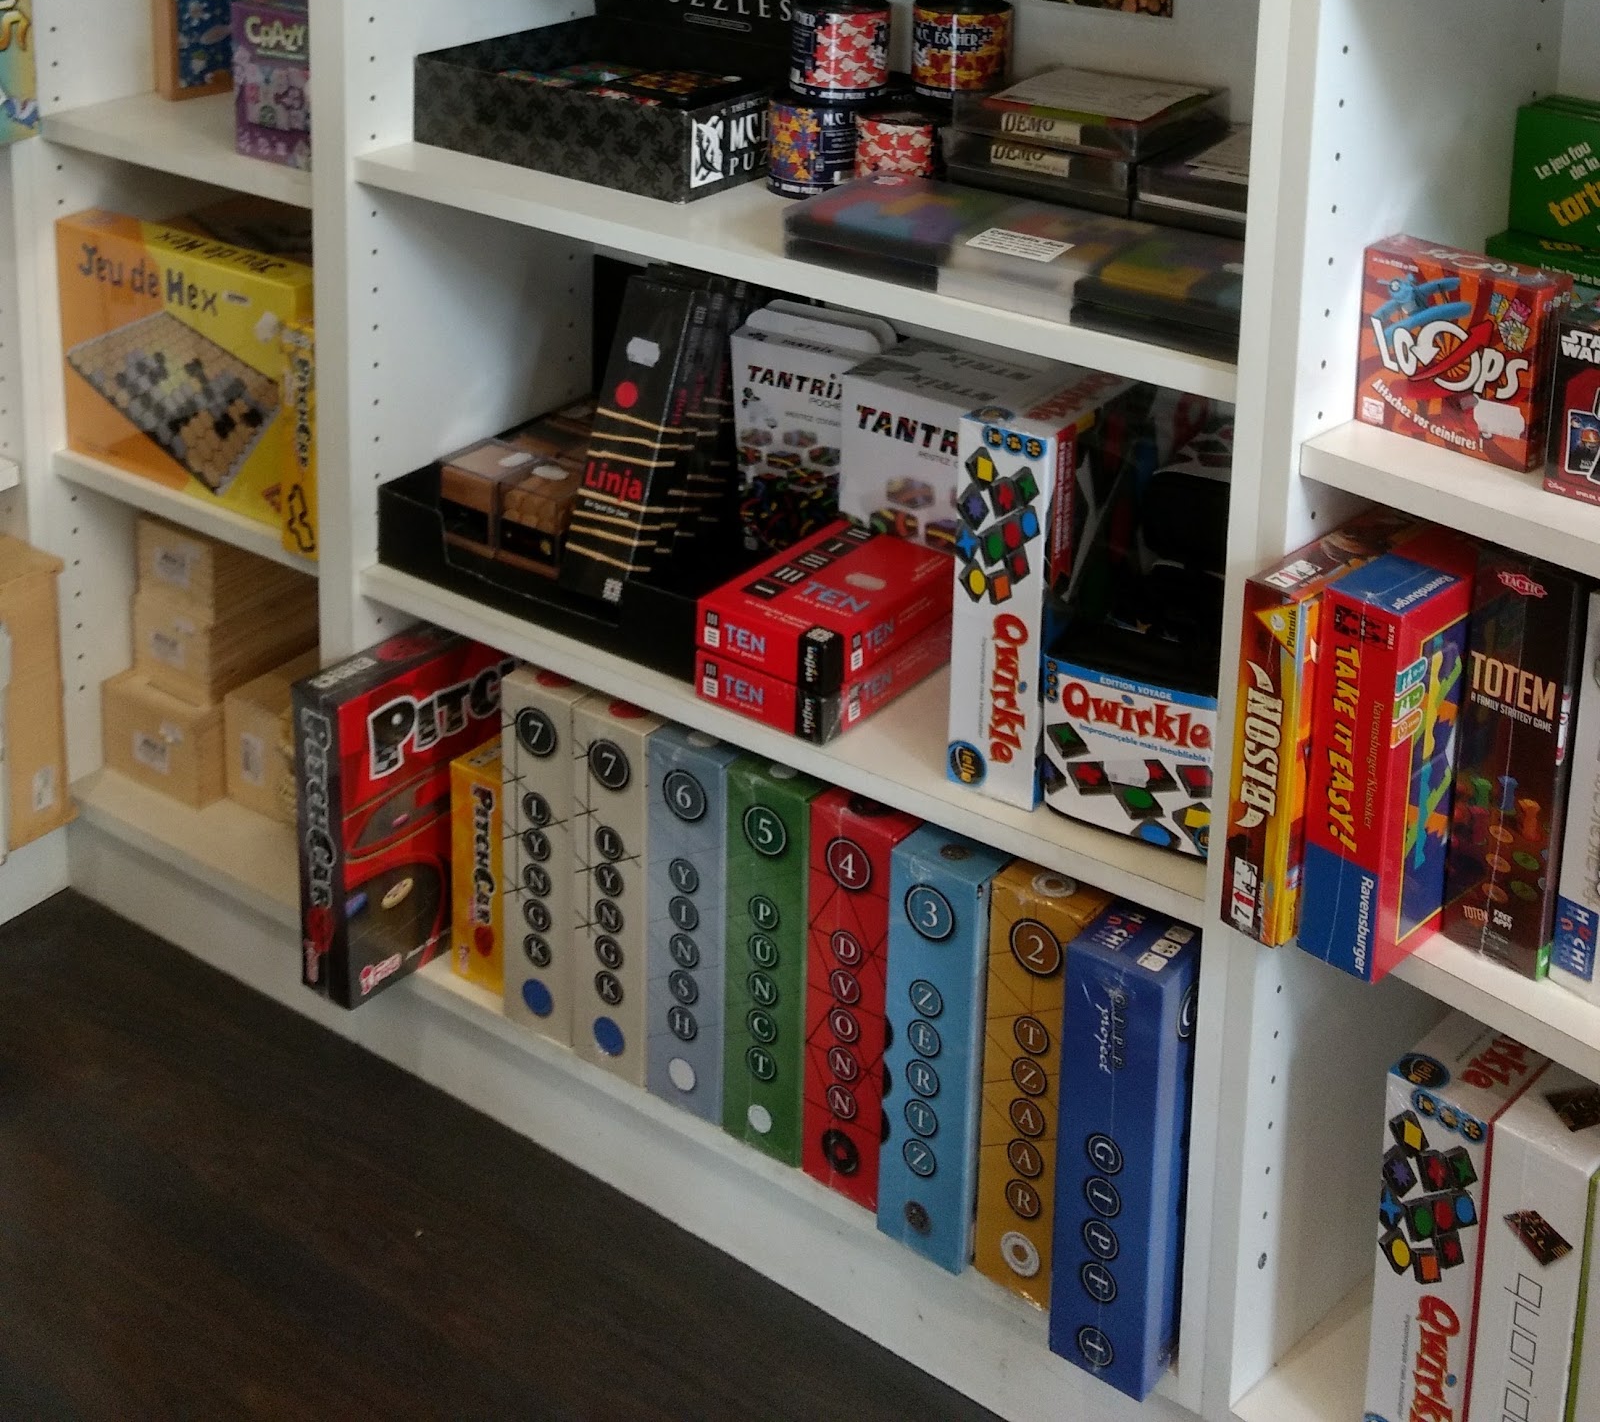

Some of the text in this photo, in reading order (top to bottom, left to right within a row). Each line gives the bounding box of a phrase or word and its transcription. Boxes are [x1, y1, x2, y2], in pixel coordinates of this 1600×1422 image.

[934, 31, 978, 47] ESCHER
[1003, 114, 1055, 133] DEMO
[992, 144, 1044, 162] DEMO
[1534, 141, 1592, 180] Le jeu fou
[1569, 162, 1588, 180] de
[79, 242, 218, 317] Jeu de Hex
[1371, 378, 1413, 419] Attachez
[1413, 412, 1430, 430] vos
[1430, 422, 1477, 451] ceintures
[585, 460, 643, 503] Linja
[799, 580, 871, 615] TEN
[1503, 573, 1544, 595] TACTIC
[723, 624, 766, 655] TEN
[865, 619, 896, 651] TEN
[1286, 609, 1297, 649] Piatnik
[723, 675, 764, 705] TEN
[989, 612, 1030, 766] Qwirkle
[1137, 685, 1172, 701] VOYAGE
[1470, 649, 1557, 721] TOTEM
[1470, 691, 1553, 734] A FAMILY STRATEGY GAME
[368, 666, 501, 780] PITC
[1061, 680, 1213, 752] Qwirkle
[1138, 739, 1158, 752] mais
[1159, 744, 1206, 762] inoubliable
[1241, 687, 1283, 817] BISON
[1327, 643, 1362, 854] TAKE IT EASY!
[1363, 700, 1385, 830] Ravensburger Klassiker
[525, 795, 549, 965] LYNGK
[599, 829, 622, 1002] LYNGK
[1352, 876, 1375, 975] Ravensburger
[1462, 904, 1489, 924] TOTEM
[1493, 908, 1514, 924] FREE
[672, 863, 695, 1037] YINSH
[831, 935, 858, 1115] DVONN
[1093, 1002, 1112, 1075] project
[1010, 1021, 1043, 1214] TZAAR
[1088, 1137, 1118, 1297] GIPF
